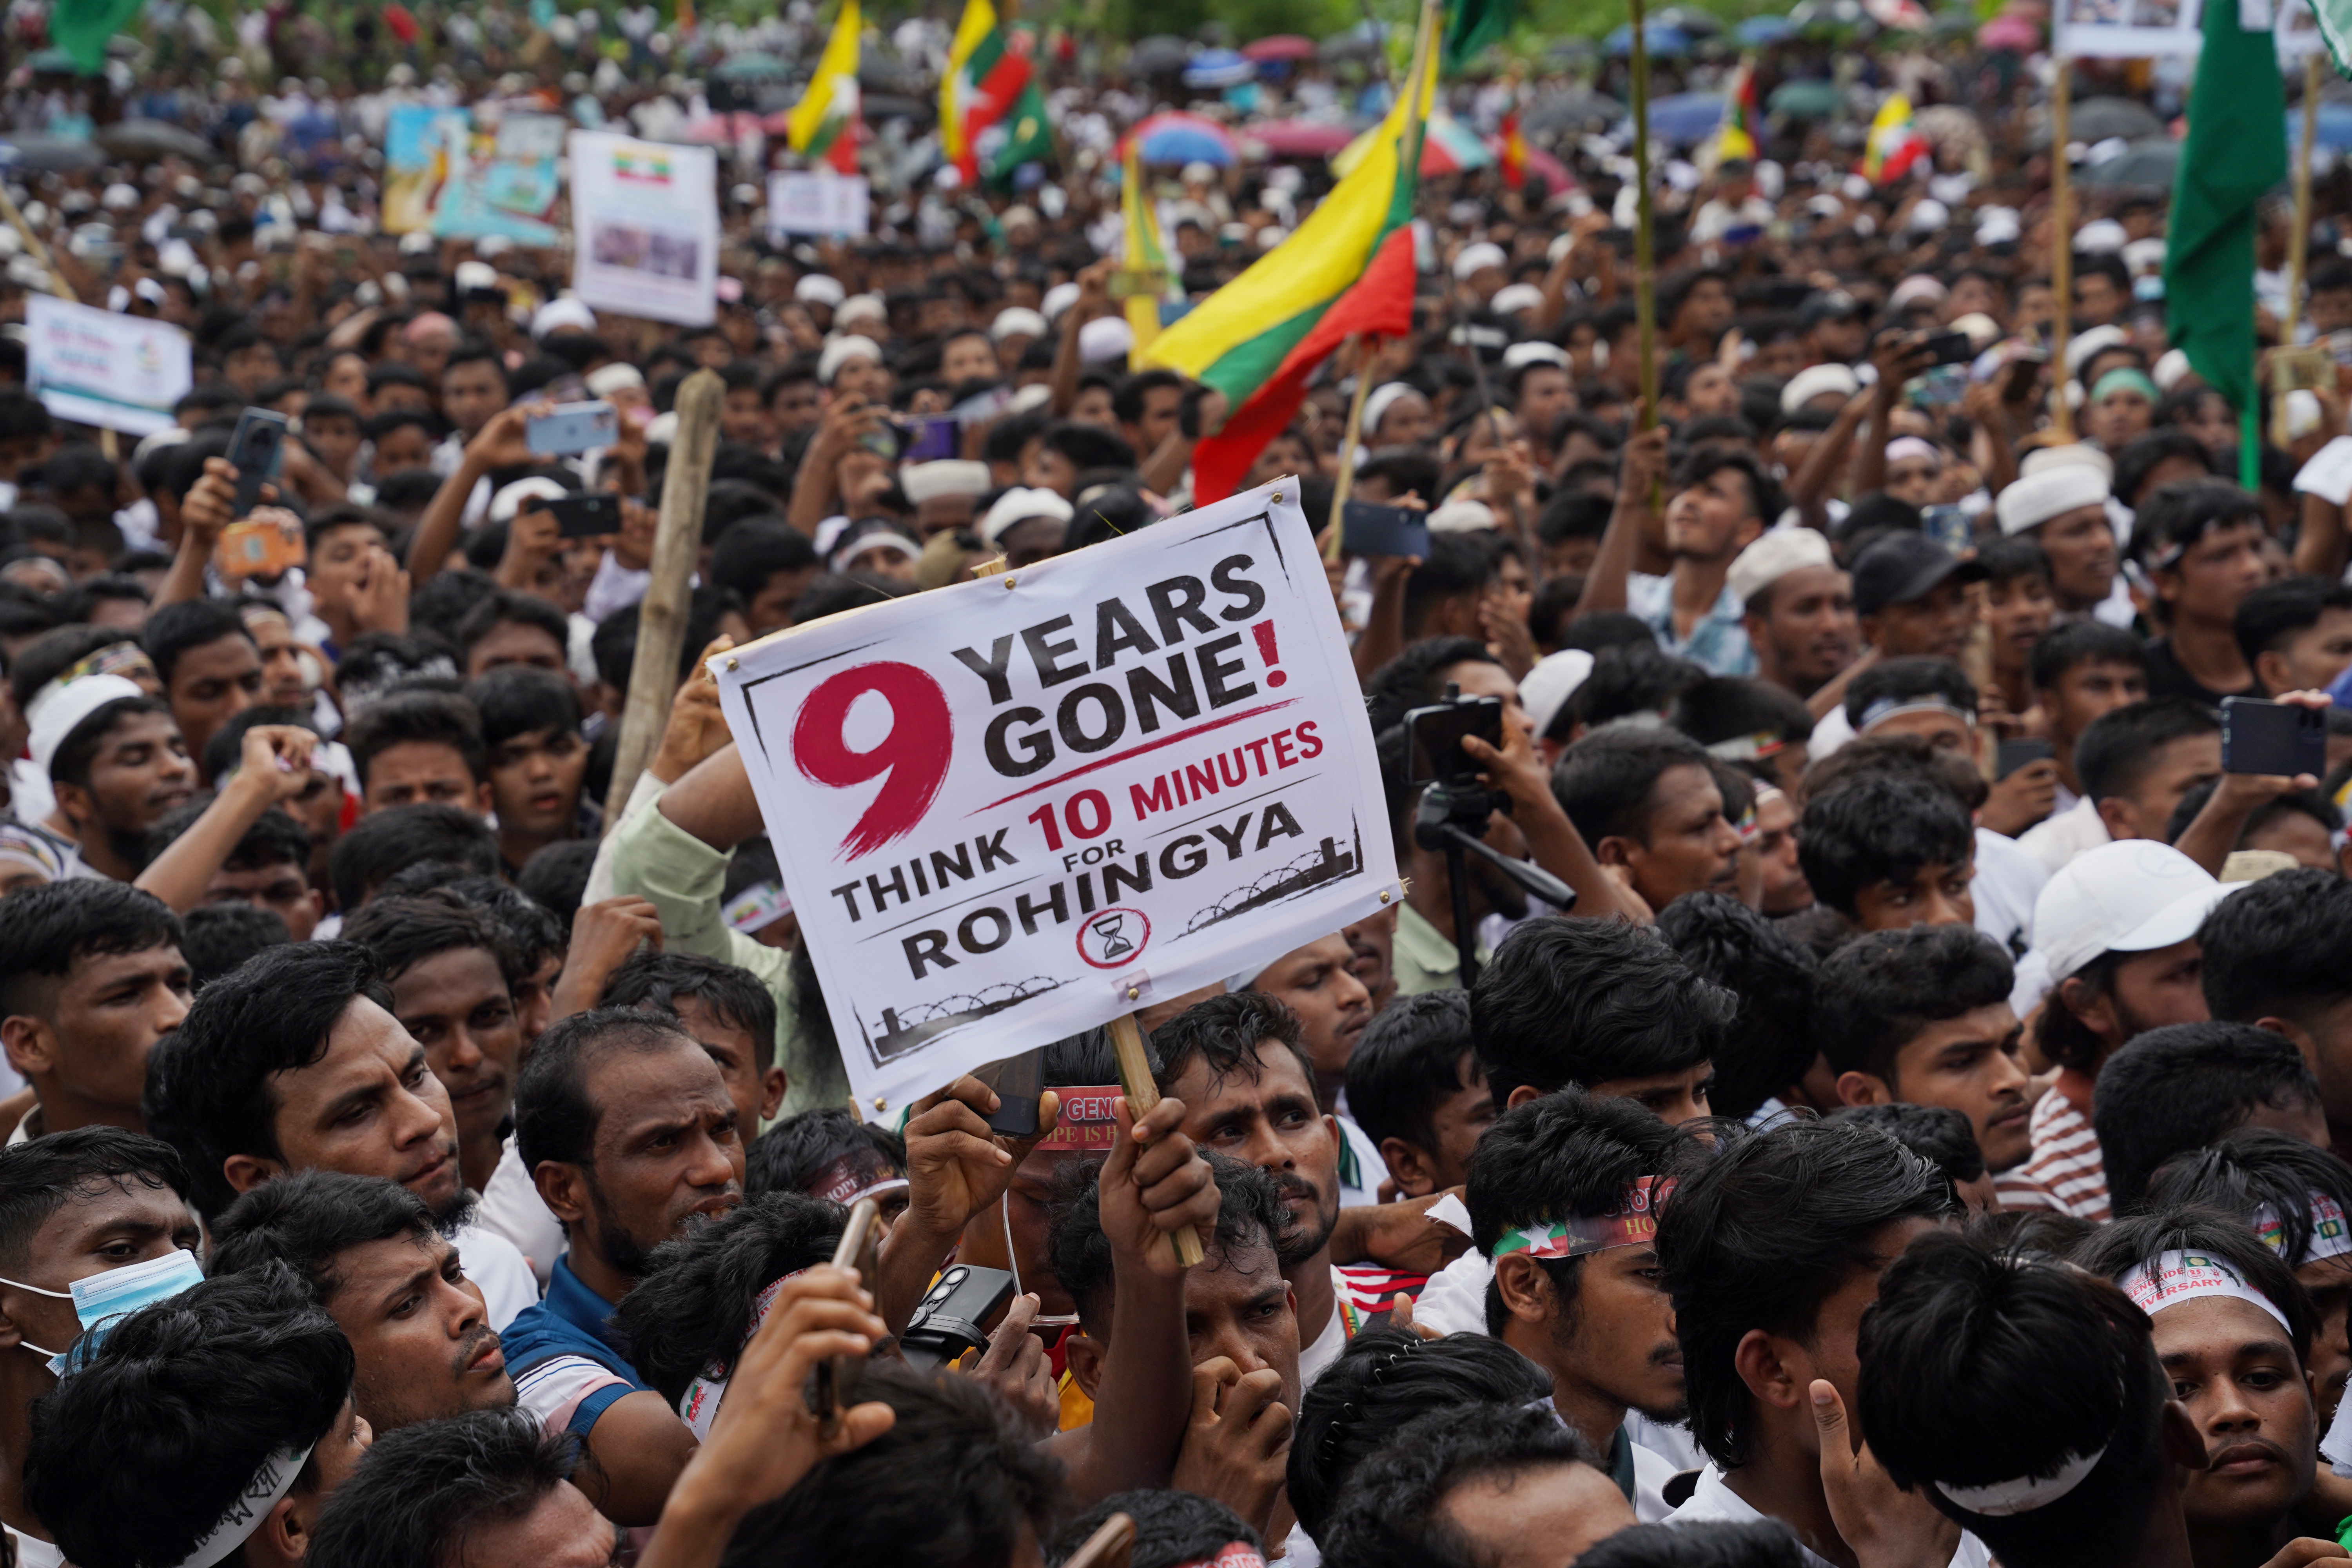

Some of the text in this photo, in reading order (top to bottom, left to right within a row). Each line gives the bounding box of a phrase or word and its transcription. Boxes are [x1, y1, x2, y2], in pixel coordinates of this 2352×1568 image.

[950, 554, 1265, 706] YEARS
[984, 620, 1287, 777] GONE!
[793, 661, 954, 863] 9
[831, 720, 1323, 923] THINK 10 MINUTES
[901, 801, 1304, 980] ROHINGYA
[1063, 839, 1125, 873] FOR
[1084, 1125, 1101, 1142] IS
[764, 1287, 779, 1301] 2026
